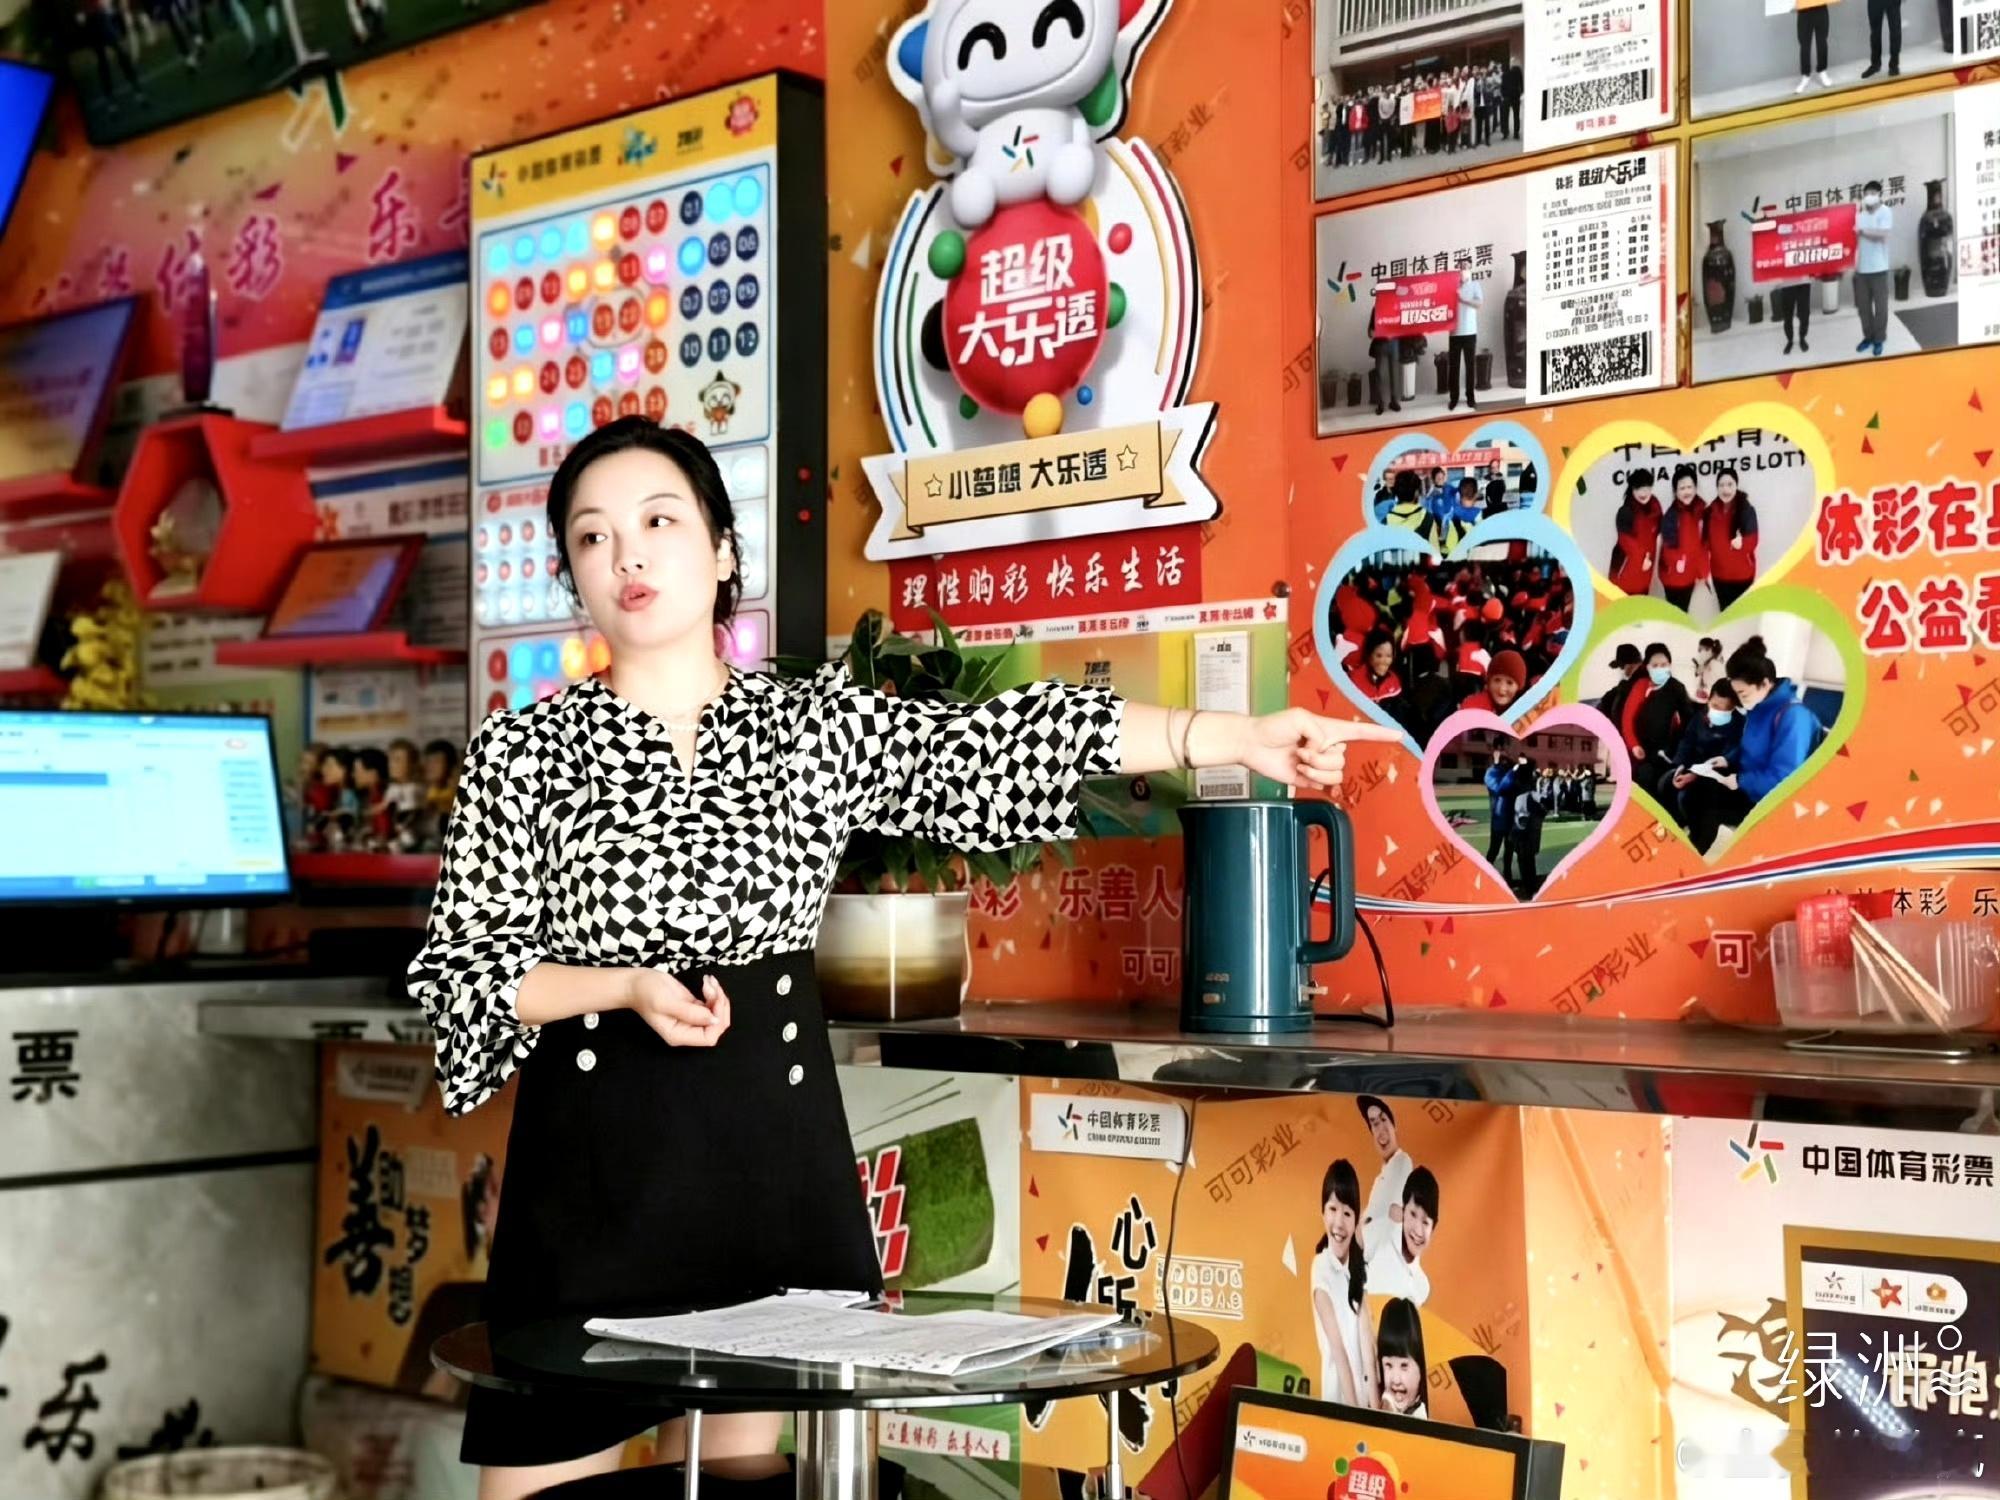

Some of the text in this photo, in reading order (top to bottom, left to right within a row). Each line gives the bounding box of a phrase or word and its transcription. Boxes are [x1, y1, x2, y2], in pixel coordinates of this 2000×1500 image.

[980, 235, 1076, 304] 超级
[957, 290, 1099, 368] 大乐透
[949, 449, 1109, 501] 小梦想 大乐透
[1816, 481, 2000, 561] 体彩在
[902, 546, 1187, 612] 理性购彩 快乐生活
[1058, 864, 1184, 920] 乐善人
[1551, 931, 1657, 1014] 可可彩业
[10, 1029, 81, 1104] 票
[1203, 1122, 1302, 1206] 可可彩业
[1802, 1144, 1995, 1188] 中国体育彩票
